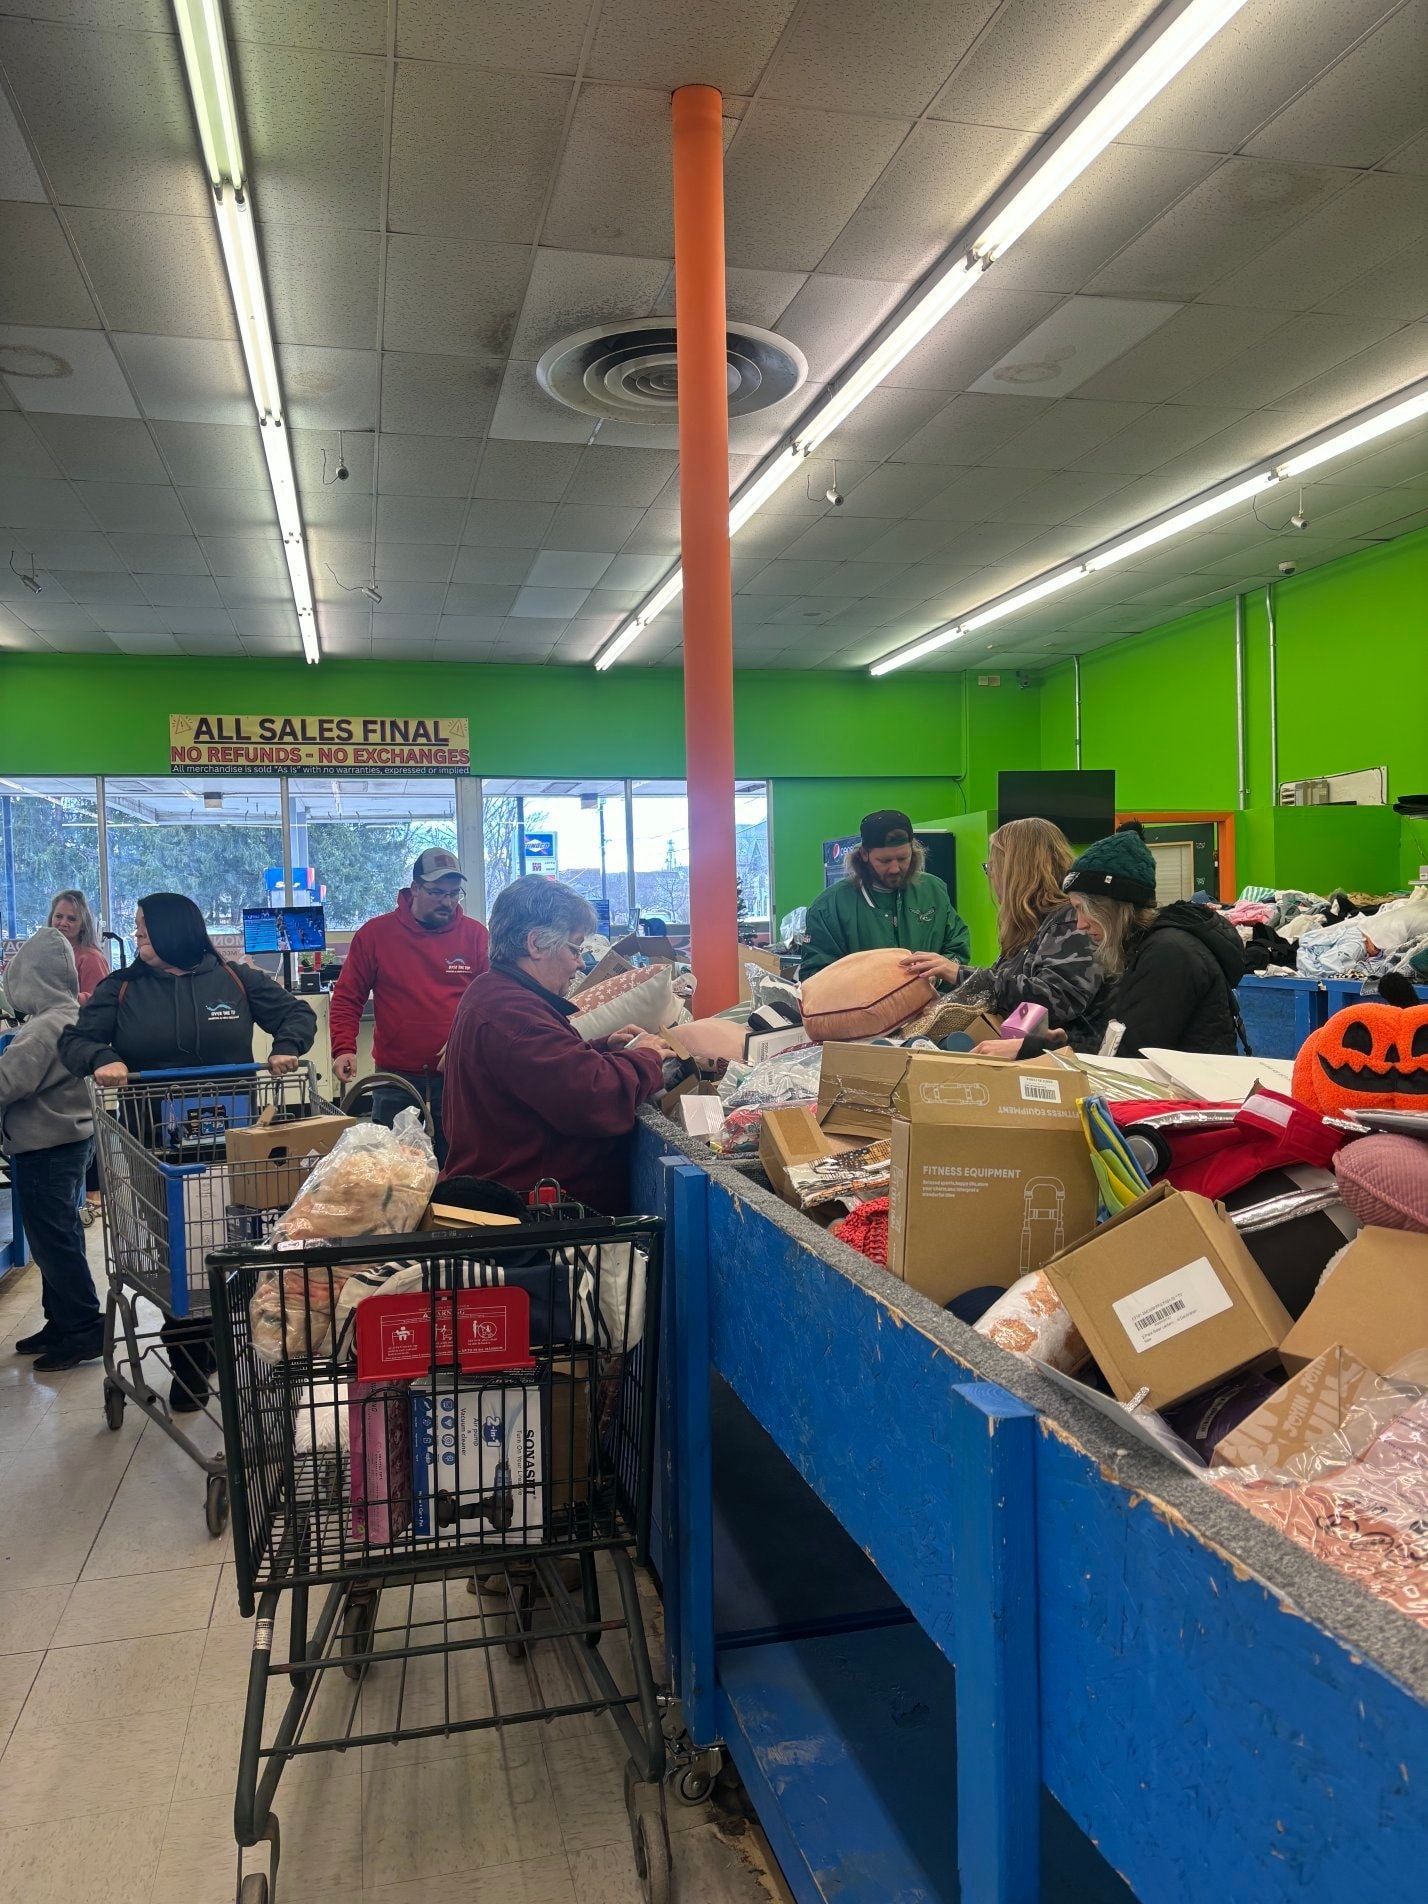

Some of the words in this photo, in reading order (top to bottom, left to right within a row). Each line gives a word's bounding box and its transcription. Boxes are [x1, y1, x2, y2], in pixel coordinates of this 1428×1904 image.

[193, 717, 252, 741] ALL
[258, 718, 354, 742] SALES
[362, 719, 450, 743] FINAL
[171, 746, 202, 763] NO
[207, 746, 302, 763] REFUNDS
[318, 747, 349, 764] NO
[353, 748, 470, 765] EXCHANGES
[172, 765, 185, 773] All
[186, 765, 242, 773] merchandise
[244, 765, 252, 773] is
[253, 765, 272, 773] sold
[302, 766, 322, 774] with
[336, 767, 383, 775] warranties,
[384, 767, 426, 775] expressed
[428, 767, 437, 775] or
[438, 766, 470, 775] implied
[997, 1106, 1046, 1116] EQUIPMENT
[922, 1165, 962, 1177] FITNESS
[964, 1167, 1021, 1179] EQUIPMENT
[472, 1428, 480, 1446] pump
[486, 1416, 502, 1447] 2-in-1
